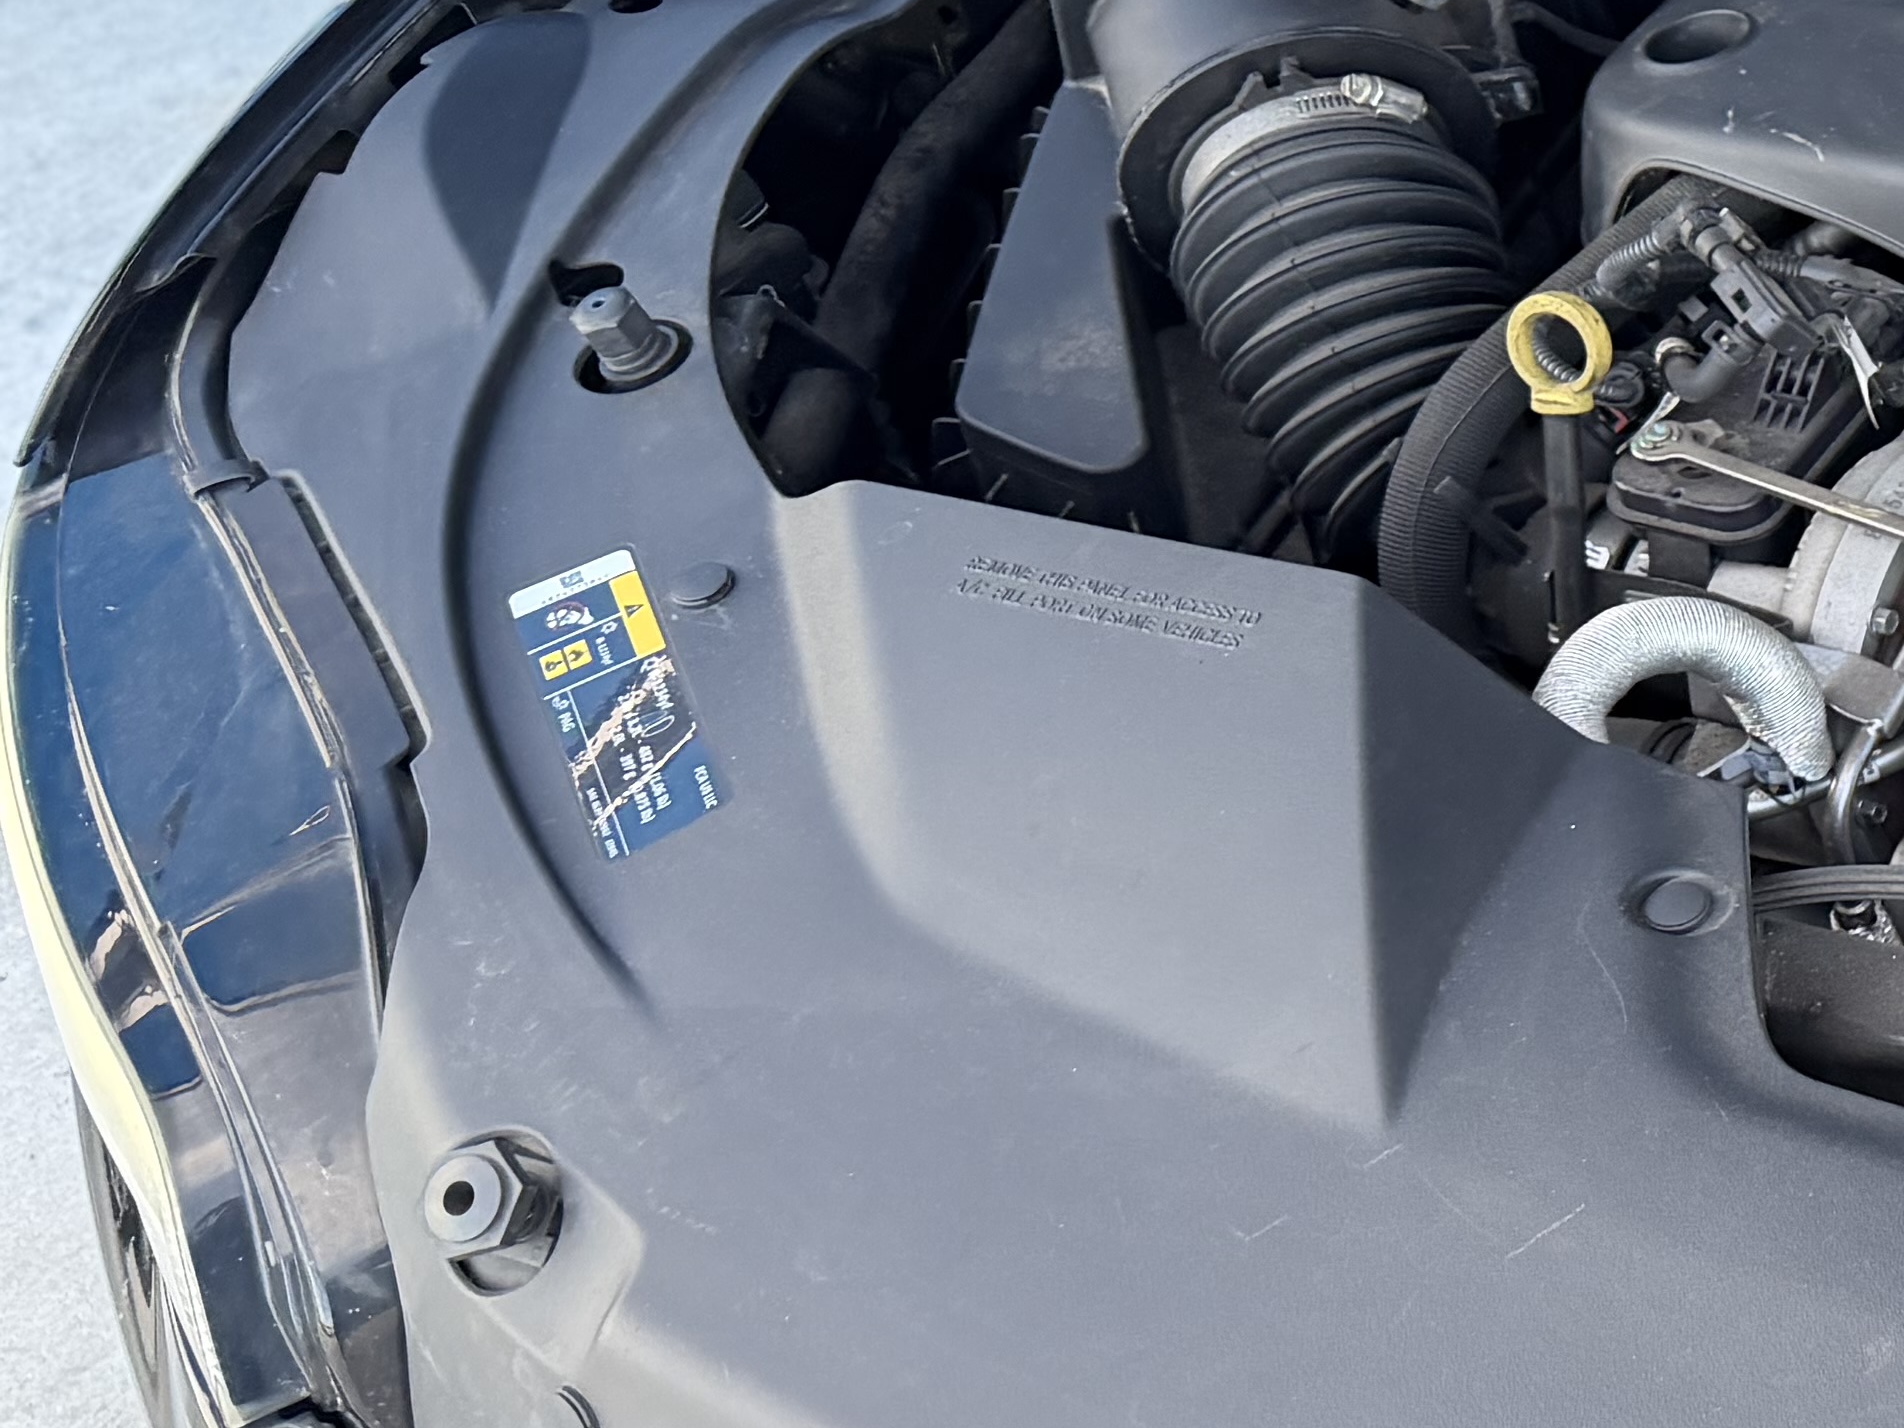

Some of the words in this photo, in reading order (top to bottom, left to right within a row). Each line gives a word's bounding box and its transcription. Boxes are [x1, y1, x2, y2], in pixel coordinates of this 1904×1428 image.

[965, 556, 1038, 583] REMOVE
[1039, 572, 1079, 591] THIS
[1076, 578, 1130, 602] PANEL
[1132, 589, 1169, 609] FOR
[1171, 596, 1238, 622] ACCESS
[1237, 608, 1262, 628] TO
[990, 586, 1027, 606] FILL
[1029, 594, 1074, 615] PORT
[1077, 603, 1108, 623] ON
[1106, 609, 1159, 634] SOME
[1161, 619, 1245, 651] VEHICLES
